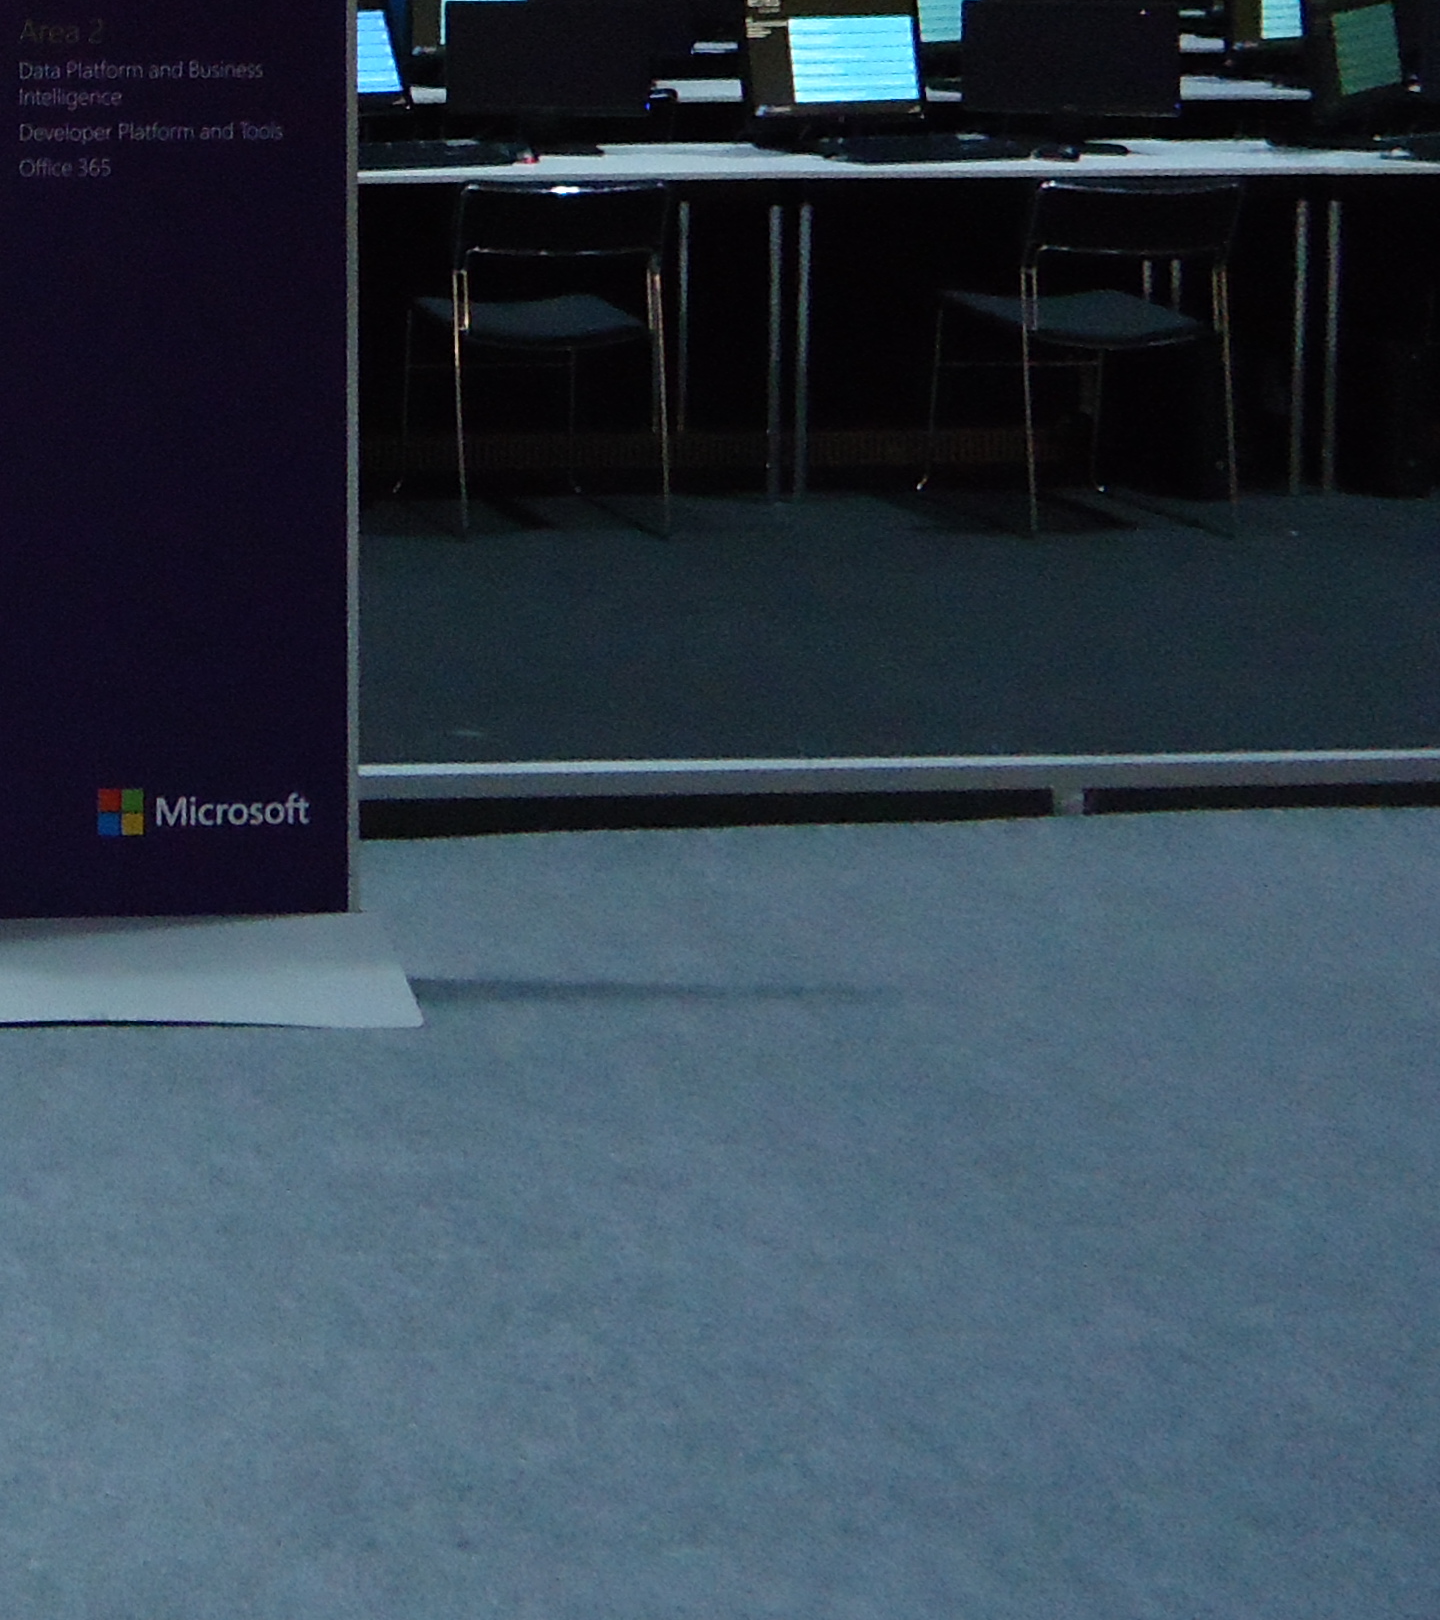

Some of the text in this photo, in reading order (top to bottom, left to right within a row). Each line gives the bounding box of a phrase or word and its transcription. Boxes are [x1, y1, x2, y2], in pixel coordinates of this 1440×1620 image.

[19, 17, 105, 45] Area 2
[18, 60, 264, 81] Data Platform and Business
[18, 87, 123, 112] Intelligence
[18, 120, 284, 146] Developer Platform and Tools
[18, 158, 112, 178] Office 365
[155, 791, 310, 827] Microsoft
